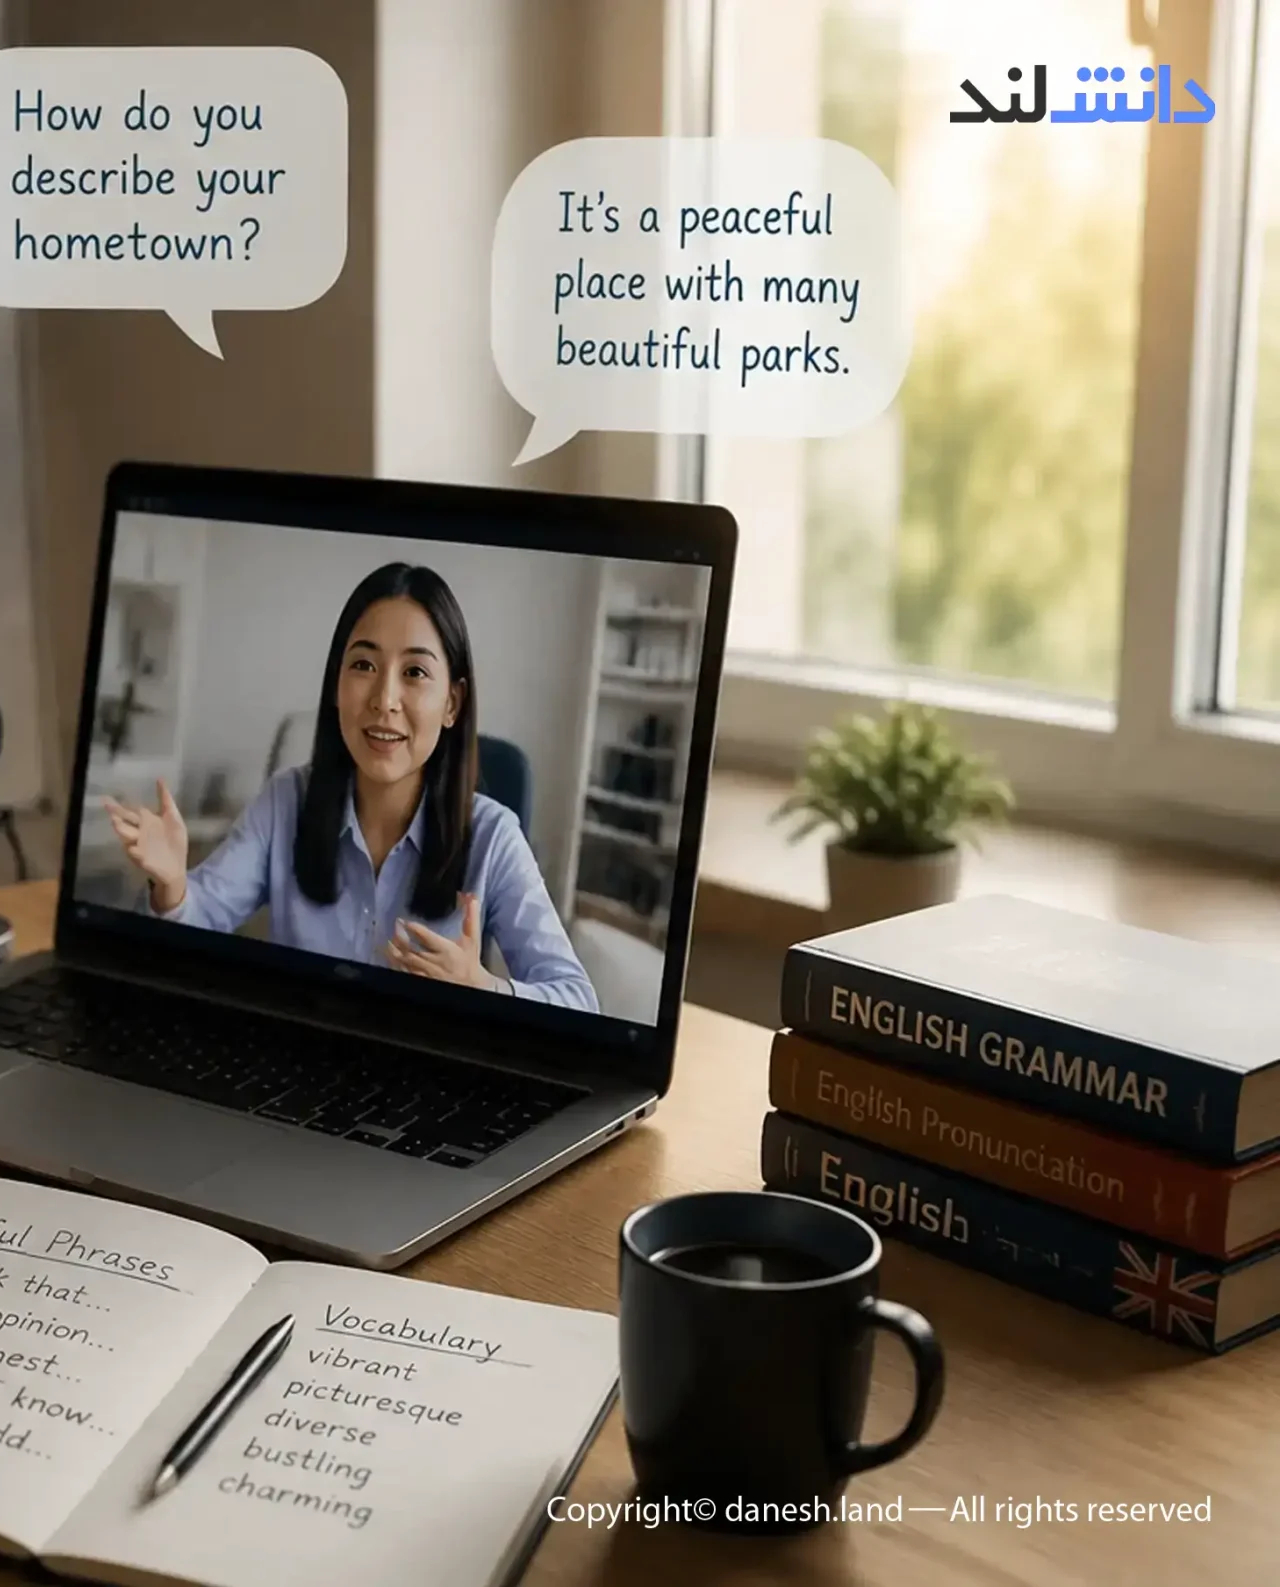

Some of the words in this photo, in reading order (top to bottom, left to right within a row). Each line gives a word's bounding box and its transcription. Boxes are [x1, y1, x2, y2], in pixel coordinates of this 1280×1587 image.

[830, 985, 968, 1058] ENGLISH
[979, 1032, 1169, 1118] GRAMMAR
[818, 1070, 912, 1132] English
[922, 1106, 1125, 1200] Pronunciation
[45, 1229, 175, 1283] Phrases
[324, 1304, 502, 1363] Vocabulary
[309, 1348, 418, 1382] vibrant
[264, 1409, 377, 1446] diverse
[283, 1379, 463, 1426] picturesque
[243, 1437, 373, 1490] bustling
[218, 1473, 374, 1530] charming
